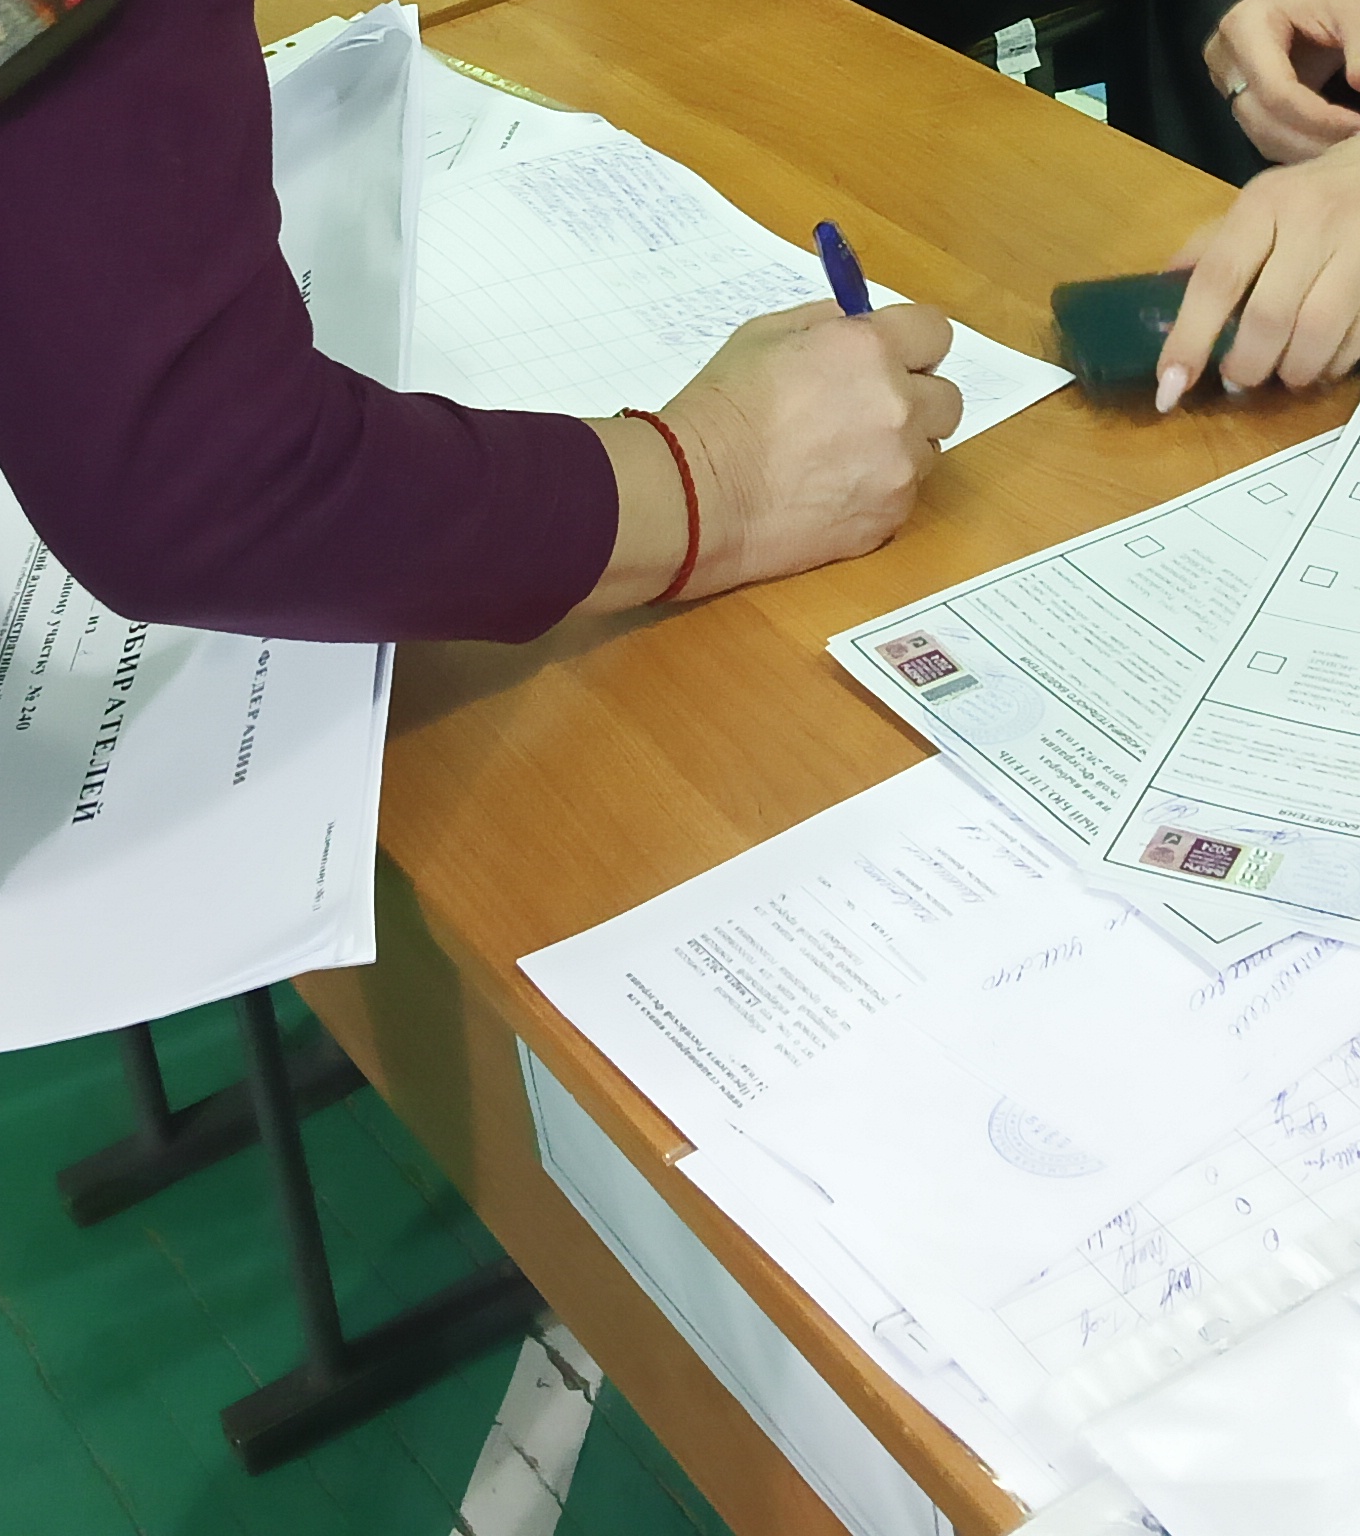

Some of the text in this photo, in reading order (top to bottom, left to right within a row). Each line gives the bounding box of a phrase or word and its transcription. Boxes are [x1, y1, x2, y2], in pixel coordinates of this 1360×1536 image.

[84, 613, 99, 636] из
[29, 617, 61, 677] участку
[23, 683, 42, 704] №
[1018, 652, 1070, 696] БЮЛЛЕТЕНЯ
[14, 704, 36, 733] 240
[231, 648, 271, 788] ФЕДЕРАЦИИ
[1054, 726, 1080, 748] года
[1064, 689, 1141, 751] ИЗБИРАТЕЛЬНОГО
[1036, 731, 1096, 783] Федерации,
[1037, 752, 1083, 791] выборах
[1075, 744, 1104, 768] 2024
[996, 747, 1073, 813] БЮЛЛЕТЕНЬ
[1080, 787, 1096, 802] на
[1276, 806, 1360, 832] БЮЛЛЕТЕНЯ
[1200, 840, 1233, 856] 2024
[623, 970, 752, 1097] Президента Российской Федерации
[662, 1028, 721, 1086] стационарного
